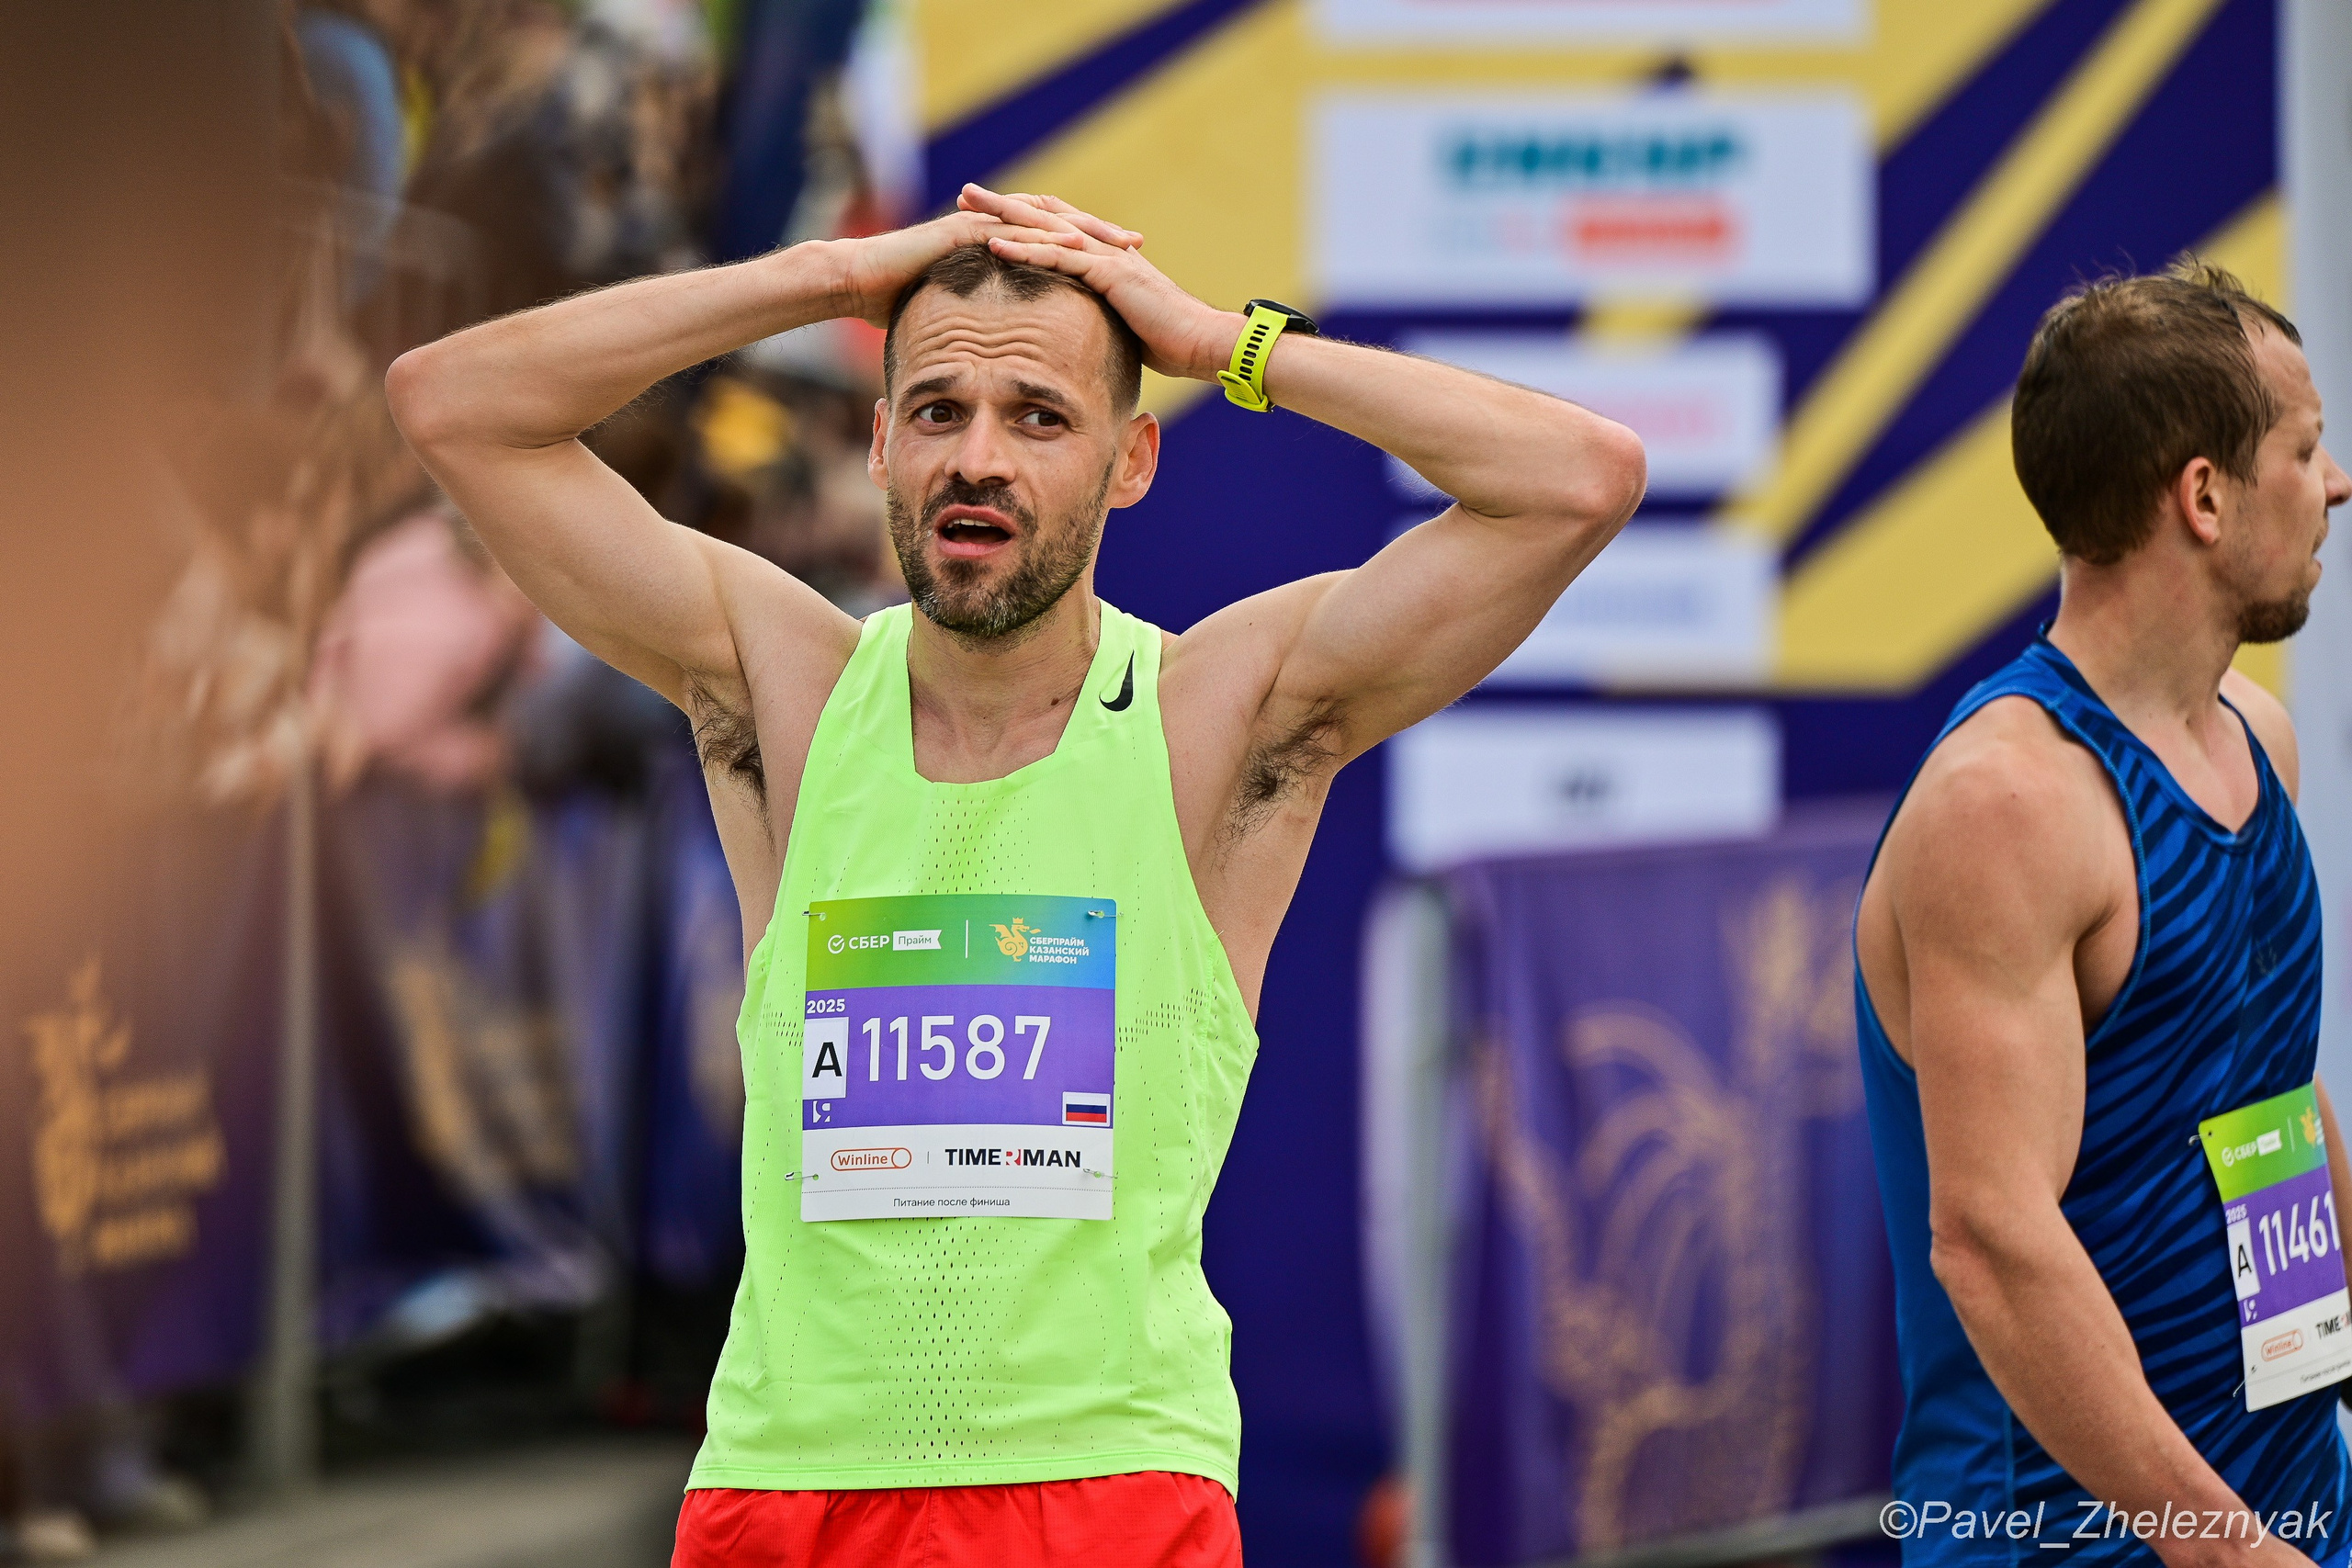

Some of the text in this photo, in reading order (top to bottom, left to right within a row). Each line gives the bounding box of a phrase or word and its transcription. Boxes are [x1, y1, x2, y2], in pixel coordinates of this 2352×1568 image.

[848, 934, 932, 950] СБЕР Прайм
[1030, 937, 1084, 947] СБЕРПРАЙМ
[1029, 945, 1090, 956] КАЗАНСКИЙ
[1029, 955, 1077, 964] МАРАФОН
[806, 998, 845, 1014] 2025
[811, 1014, 1051, 1081] A 11587
[838, 1154, 888, 1166] Winline
[944, 1148, 1081, 1168] TIMERMAN
[893, 1197, 1011, 1208] Питание после финиша
[2238, 1190, 2341, 1279] A 11461
